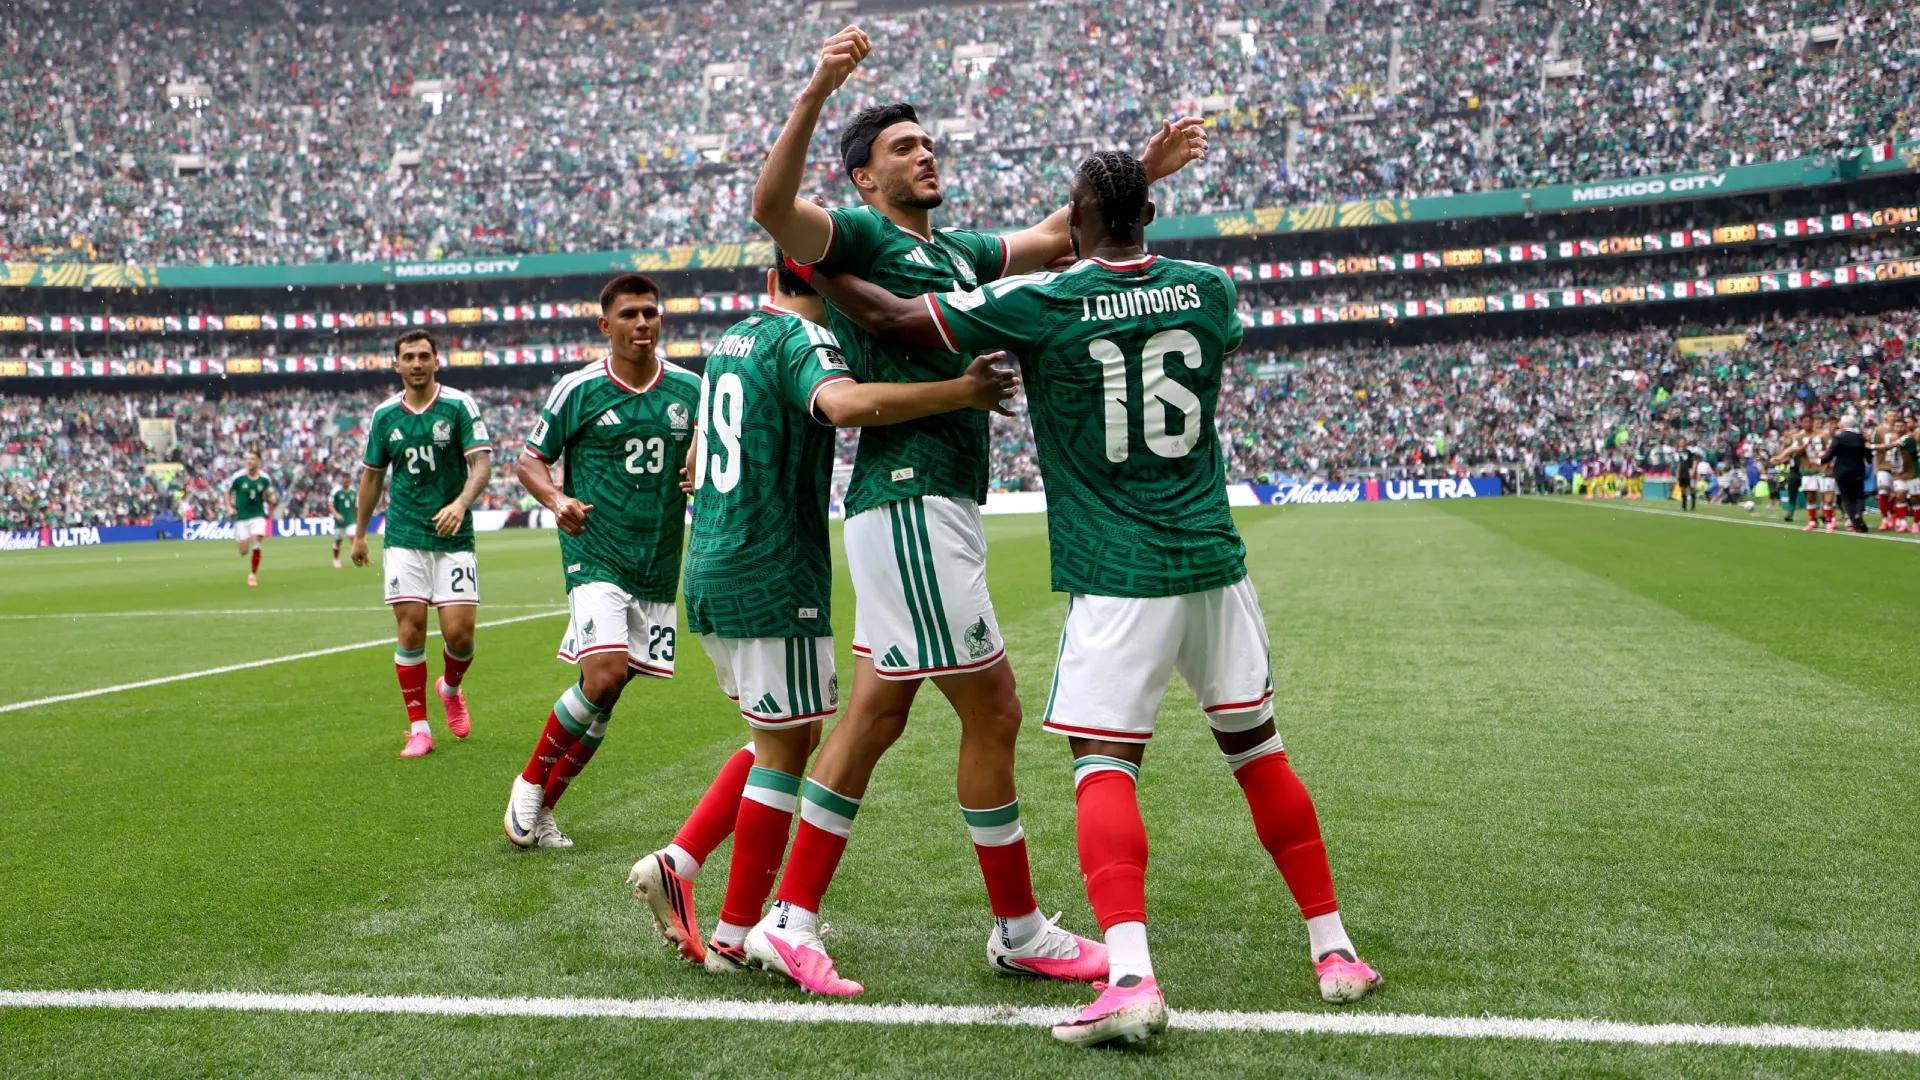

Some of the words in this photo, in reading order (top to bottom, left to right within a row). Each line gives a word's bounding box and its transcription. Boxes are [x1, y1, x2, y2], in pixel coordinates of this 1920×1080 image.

[1572, 180, 1665, 202] MEXICO
[1669, 174, 1727, 192] CITY
[395, 262, 471, 277] MEXICO
[474, 260, 519, 274] CITY
[1081, 283, 1201, 322] J.QUIÑONES
[1088, 329, 1202, 463] 16
[694, 372, 744, 494] 19
[405, 445, 436, 475] 24
[625, 437, 665, 474] 23
[1271, 482, 1360, 506] Michelob
[1385, 478, 1476, 500] ULTRA
[52, 526, 101, 548] ULTRA
[277, 518, 335, 537] ULTR
[451, 567, 476, 593] 24
[648, 624, 676, 662] 23
